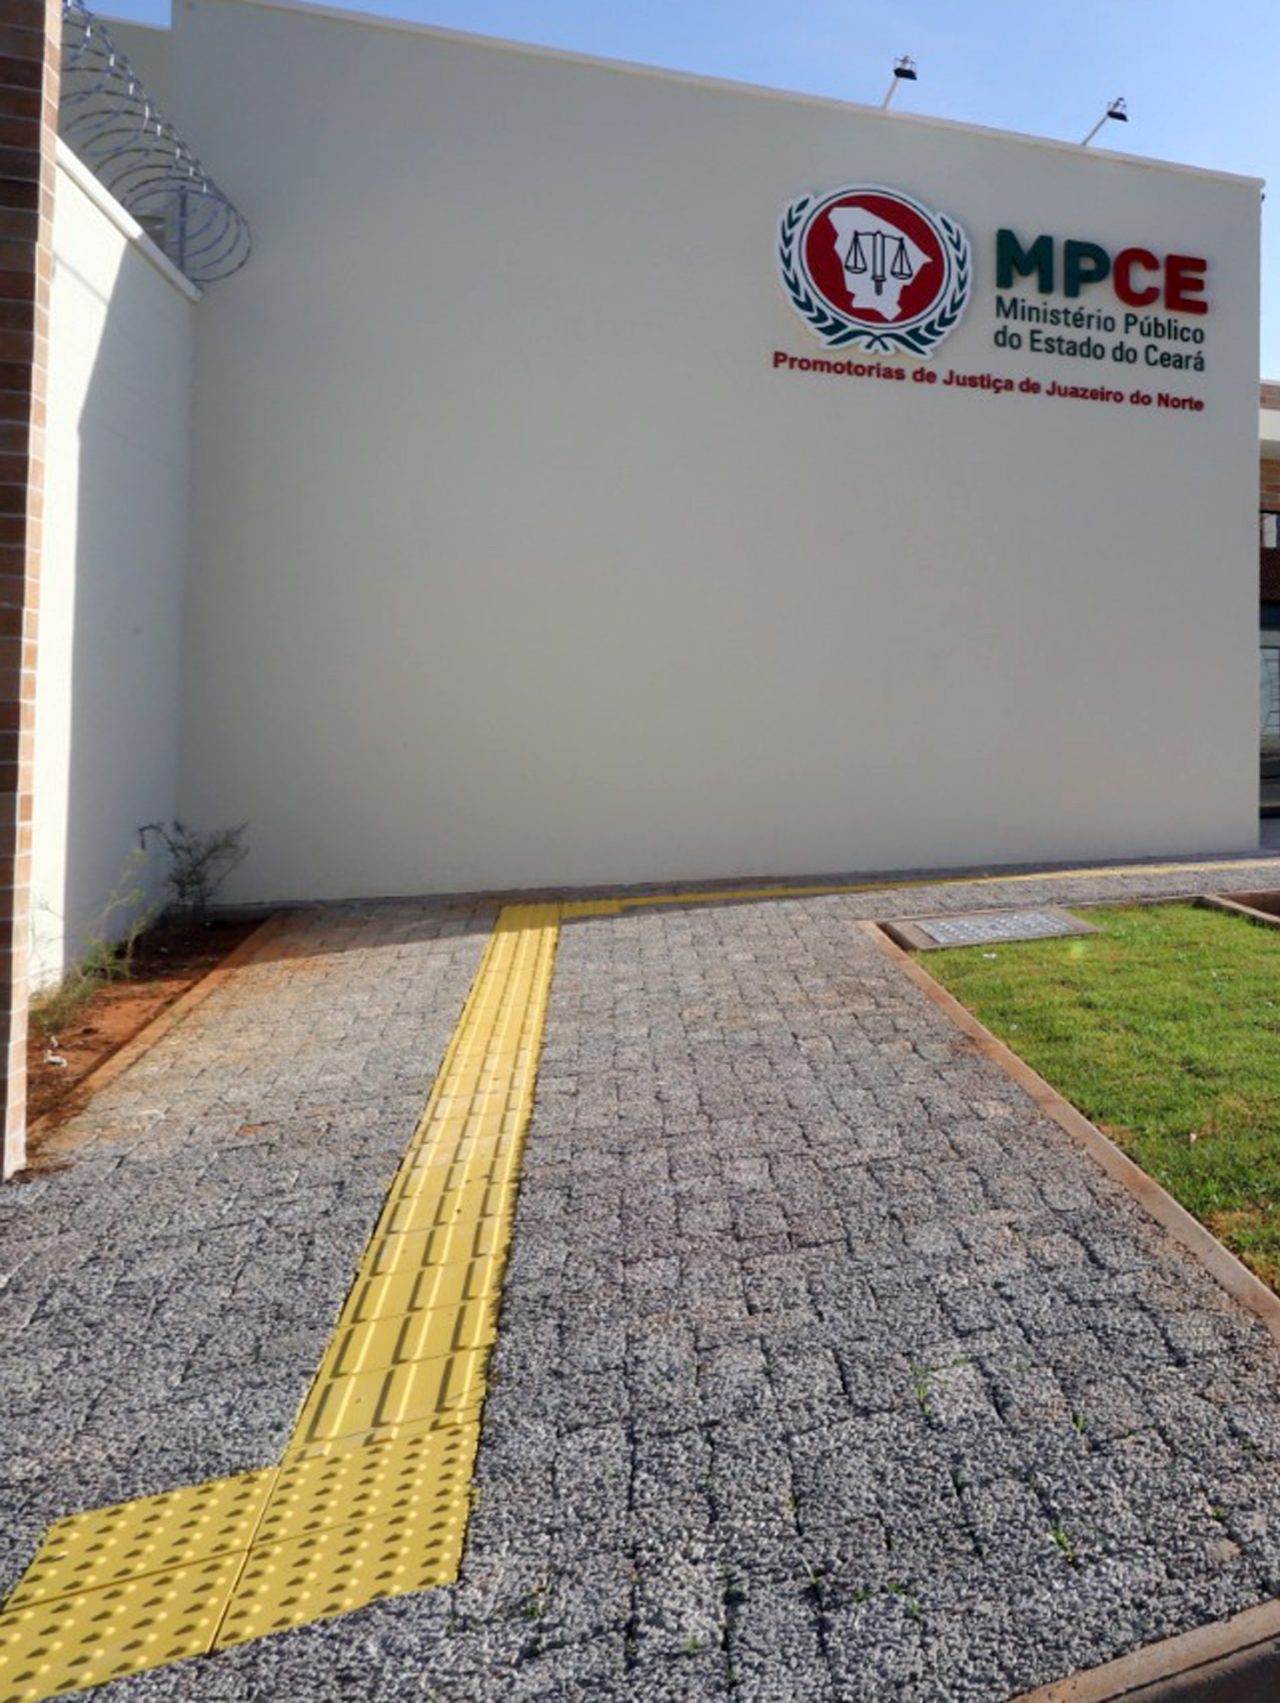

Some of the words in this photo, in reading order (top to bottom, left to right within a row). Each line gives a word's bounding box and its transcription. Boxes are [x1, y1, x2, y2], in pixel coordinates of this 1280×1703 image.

[995, 228, 1208, 315] MPCE
[995, 295, 1116, 333] Ministério
[1124, 313, 1205, 345] Público
[994, 325, 1022, 350] do
[1030, 329, 1105, 361] Estado
[1112, 341, 1137, 364] do
[1145, 344, 1205, 372] Ceará
[773, 351, 906, 381] Promotorias
[912, 366, 938, 384] de
[942, 370, 1014, 394] Justiça
[1018, 377, 1041, 394] de
[1046, 381, 1124, 404] Juazeiro
[1129, 389, 1152, 406] do
[1157, 392, 1204, 412] Norte
